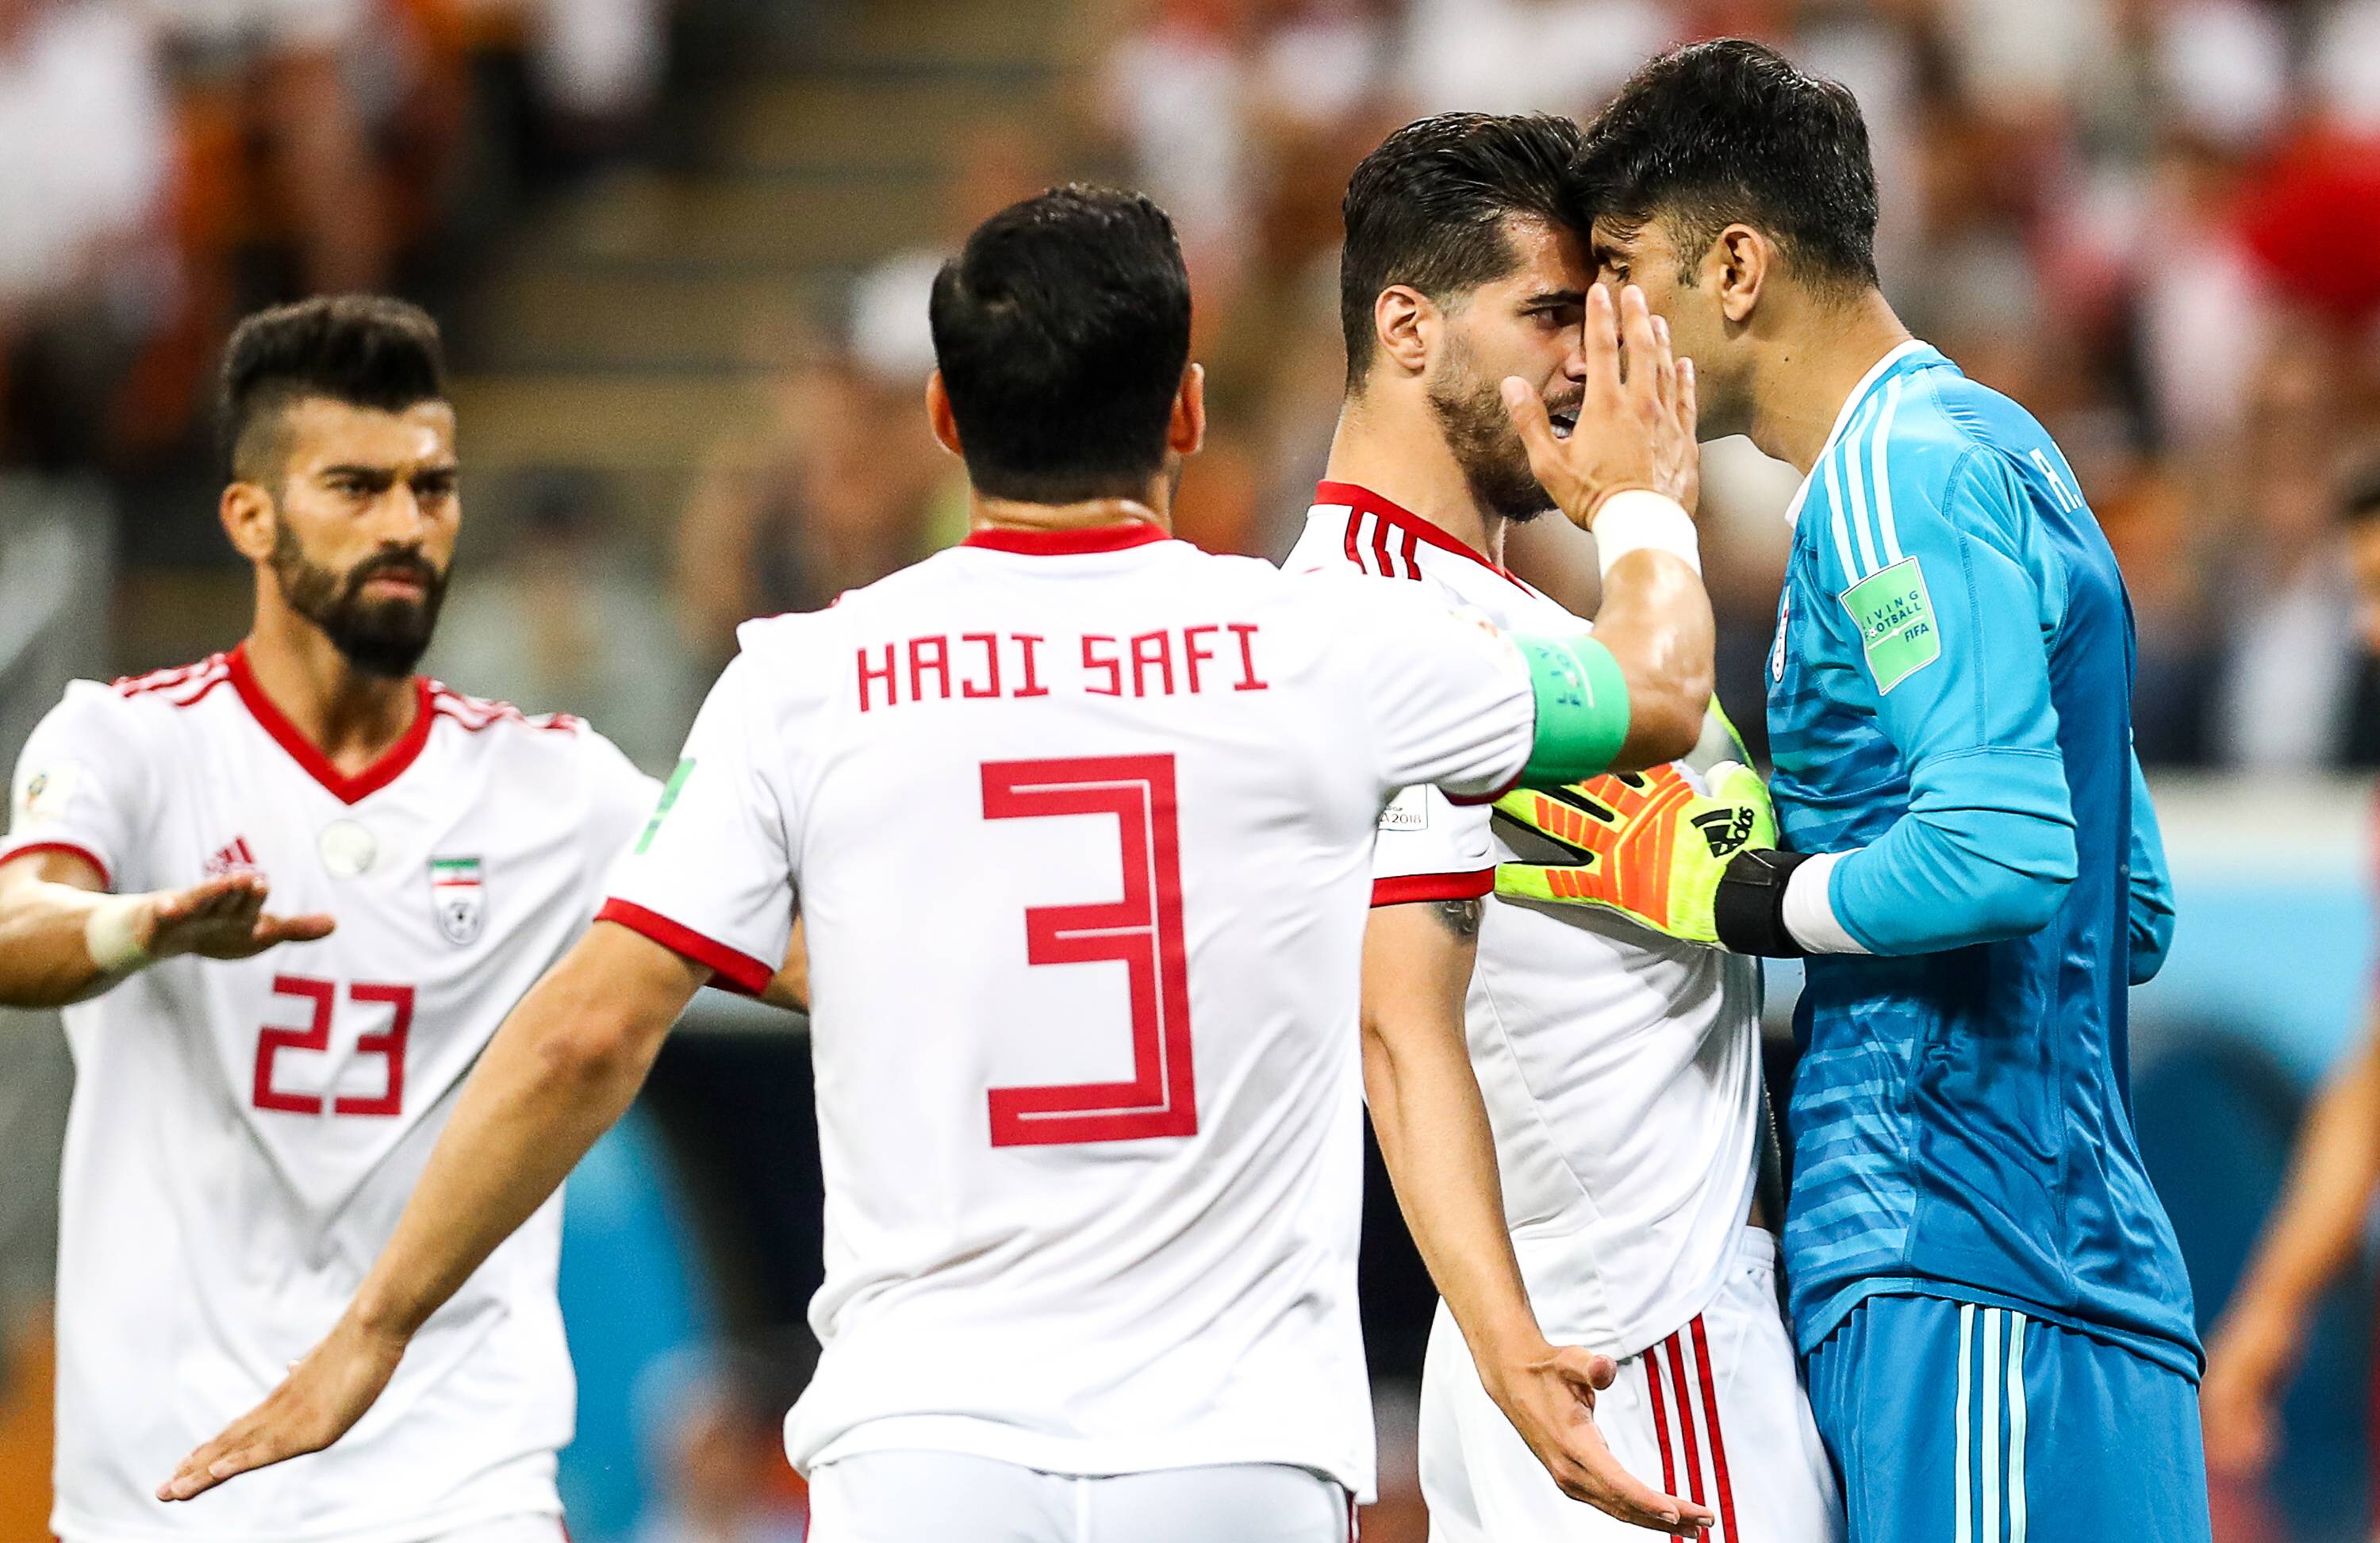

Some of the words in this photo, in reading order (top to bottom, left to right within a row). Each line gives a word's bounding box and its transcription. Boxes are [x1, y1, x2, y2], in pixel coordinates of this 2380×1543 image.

[1861, 589, 1919, 631] LIVING
[1864, 602, 1923, 643] FOOTBALL
[1905, 623, 1931, 643] FIFA
[857, 632, 1049, 712] HAJI
[1081, 623, 1269, 697] SAFI
[980, 753, 1198, 1147] 3
[253, 974, 415, 1115] 23
